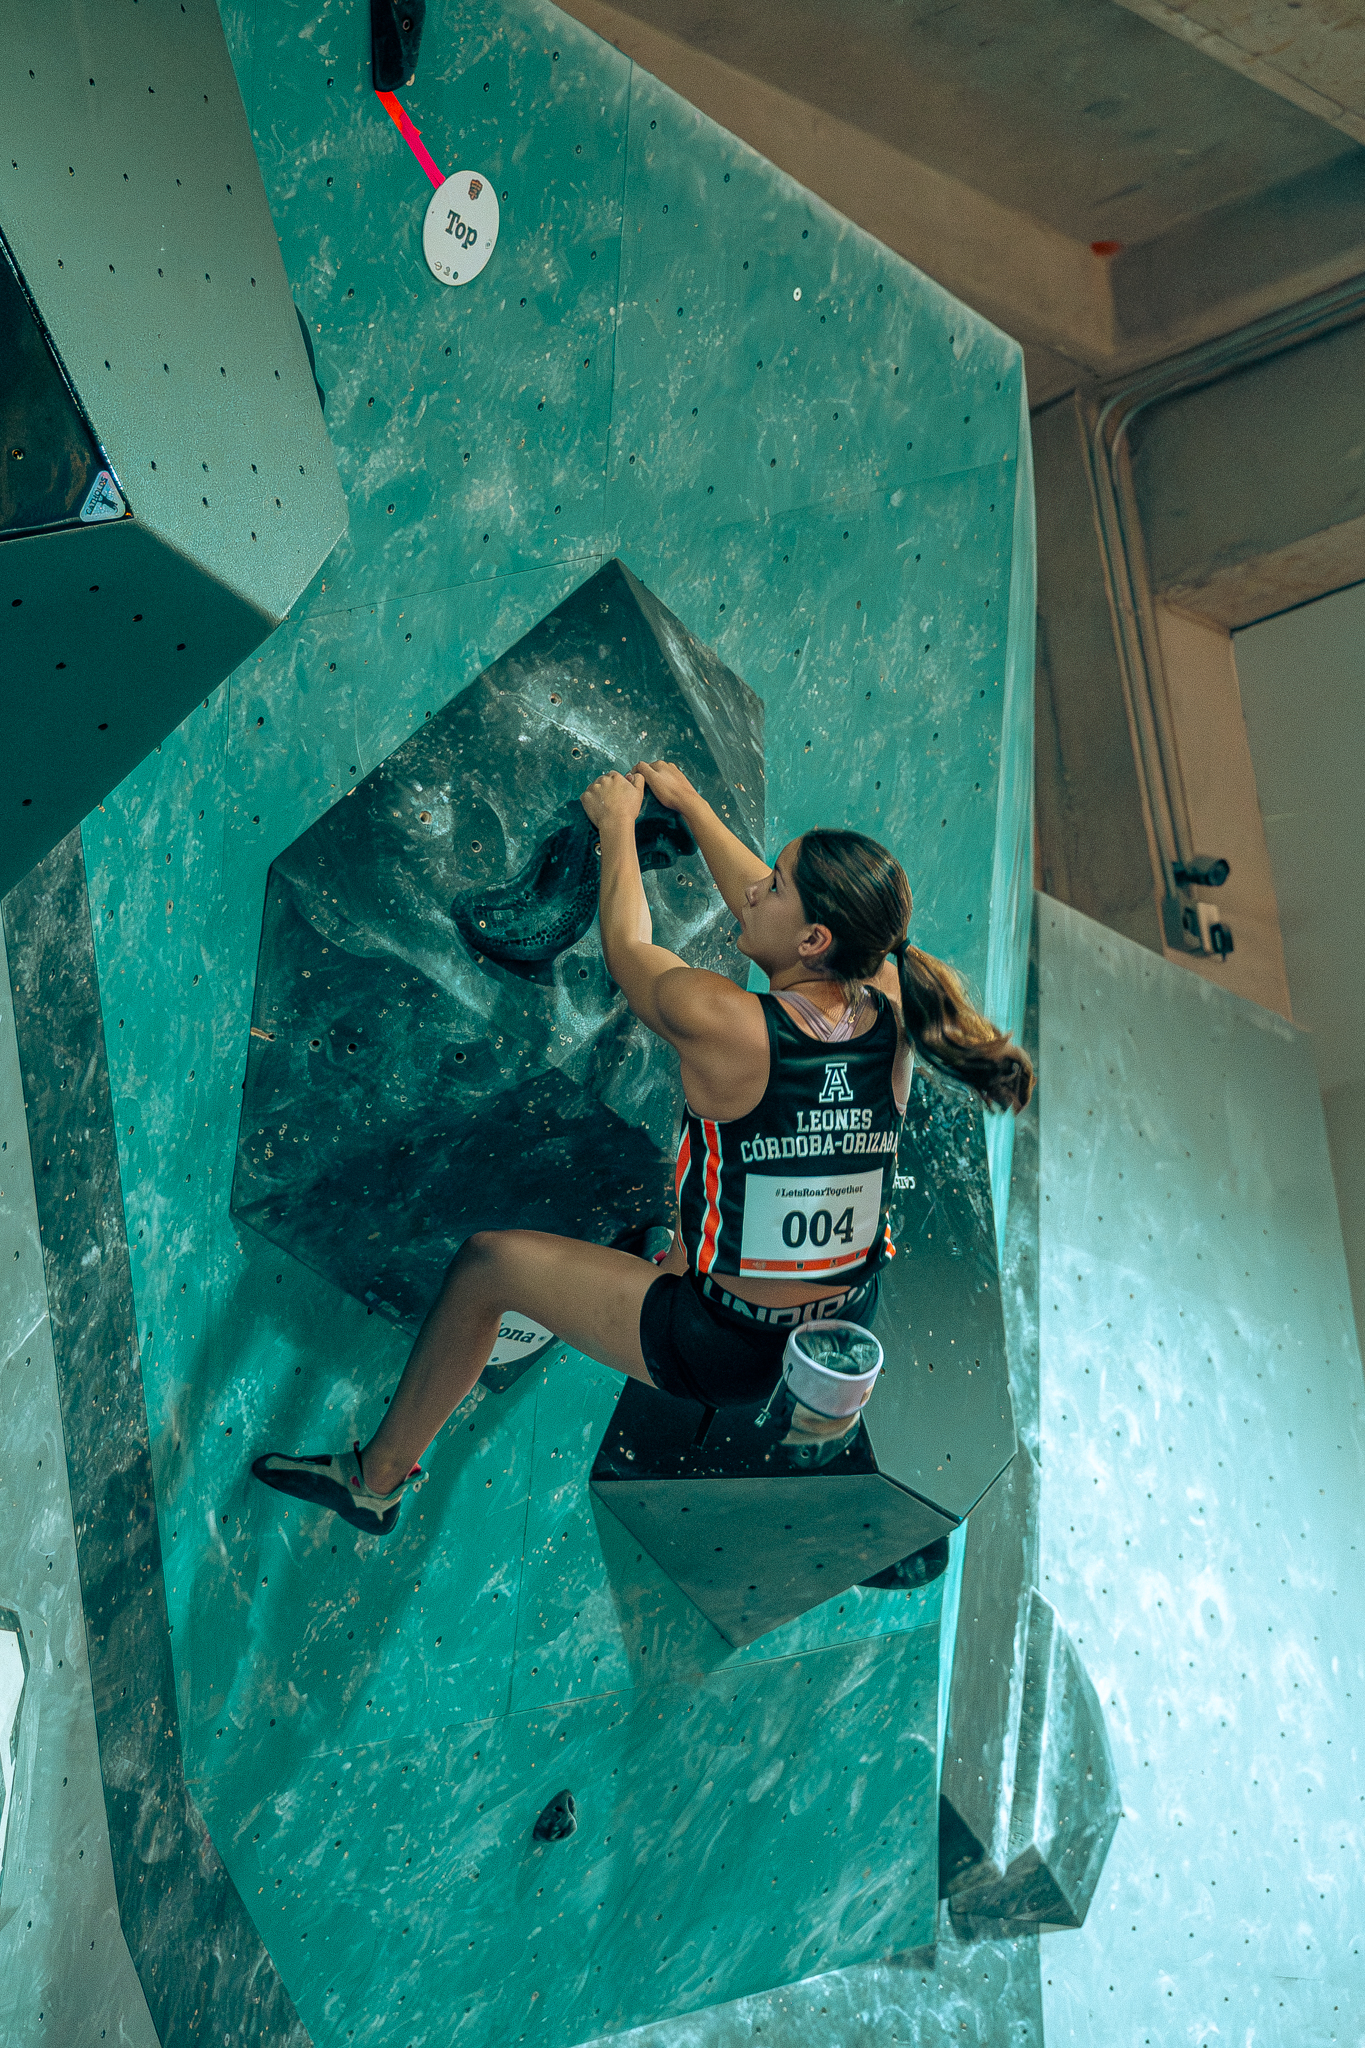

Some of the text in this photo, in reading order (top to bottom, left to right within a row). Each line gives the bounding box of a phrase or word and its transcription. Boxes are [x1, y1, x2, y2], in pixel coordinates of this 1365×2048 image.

[445, 209, 478, 250] Top
[819, 1062, 854, 1103] A
[797, 1108, 873, 1133] LEONES
[740, 1131, 898, 1163] CÓRDOBA-ORIZABA
[775, 1184, 864, 1198] #LetsRoarTogether
[781, 1206, 854, 1248] 004
[498, 1322, 536, 1343] ona
